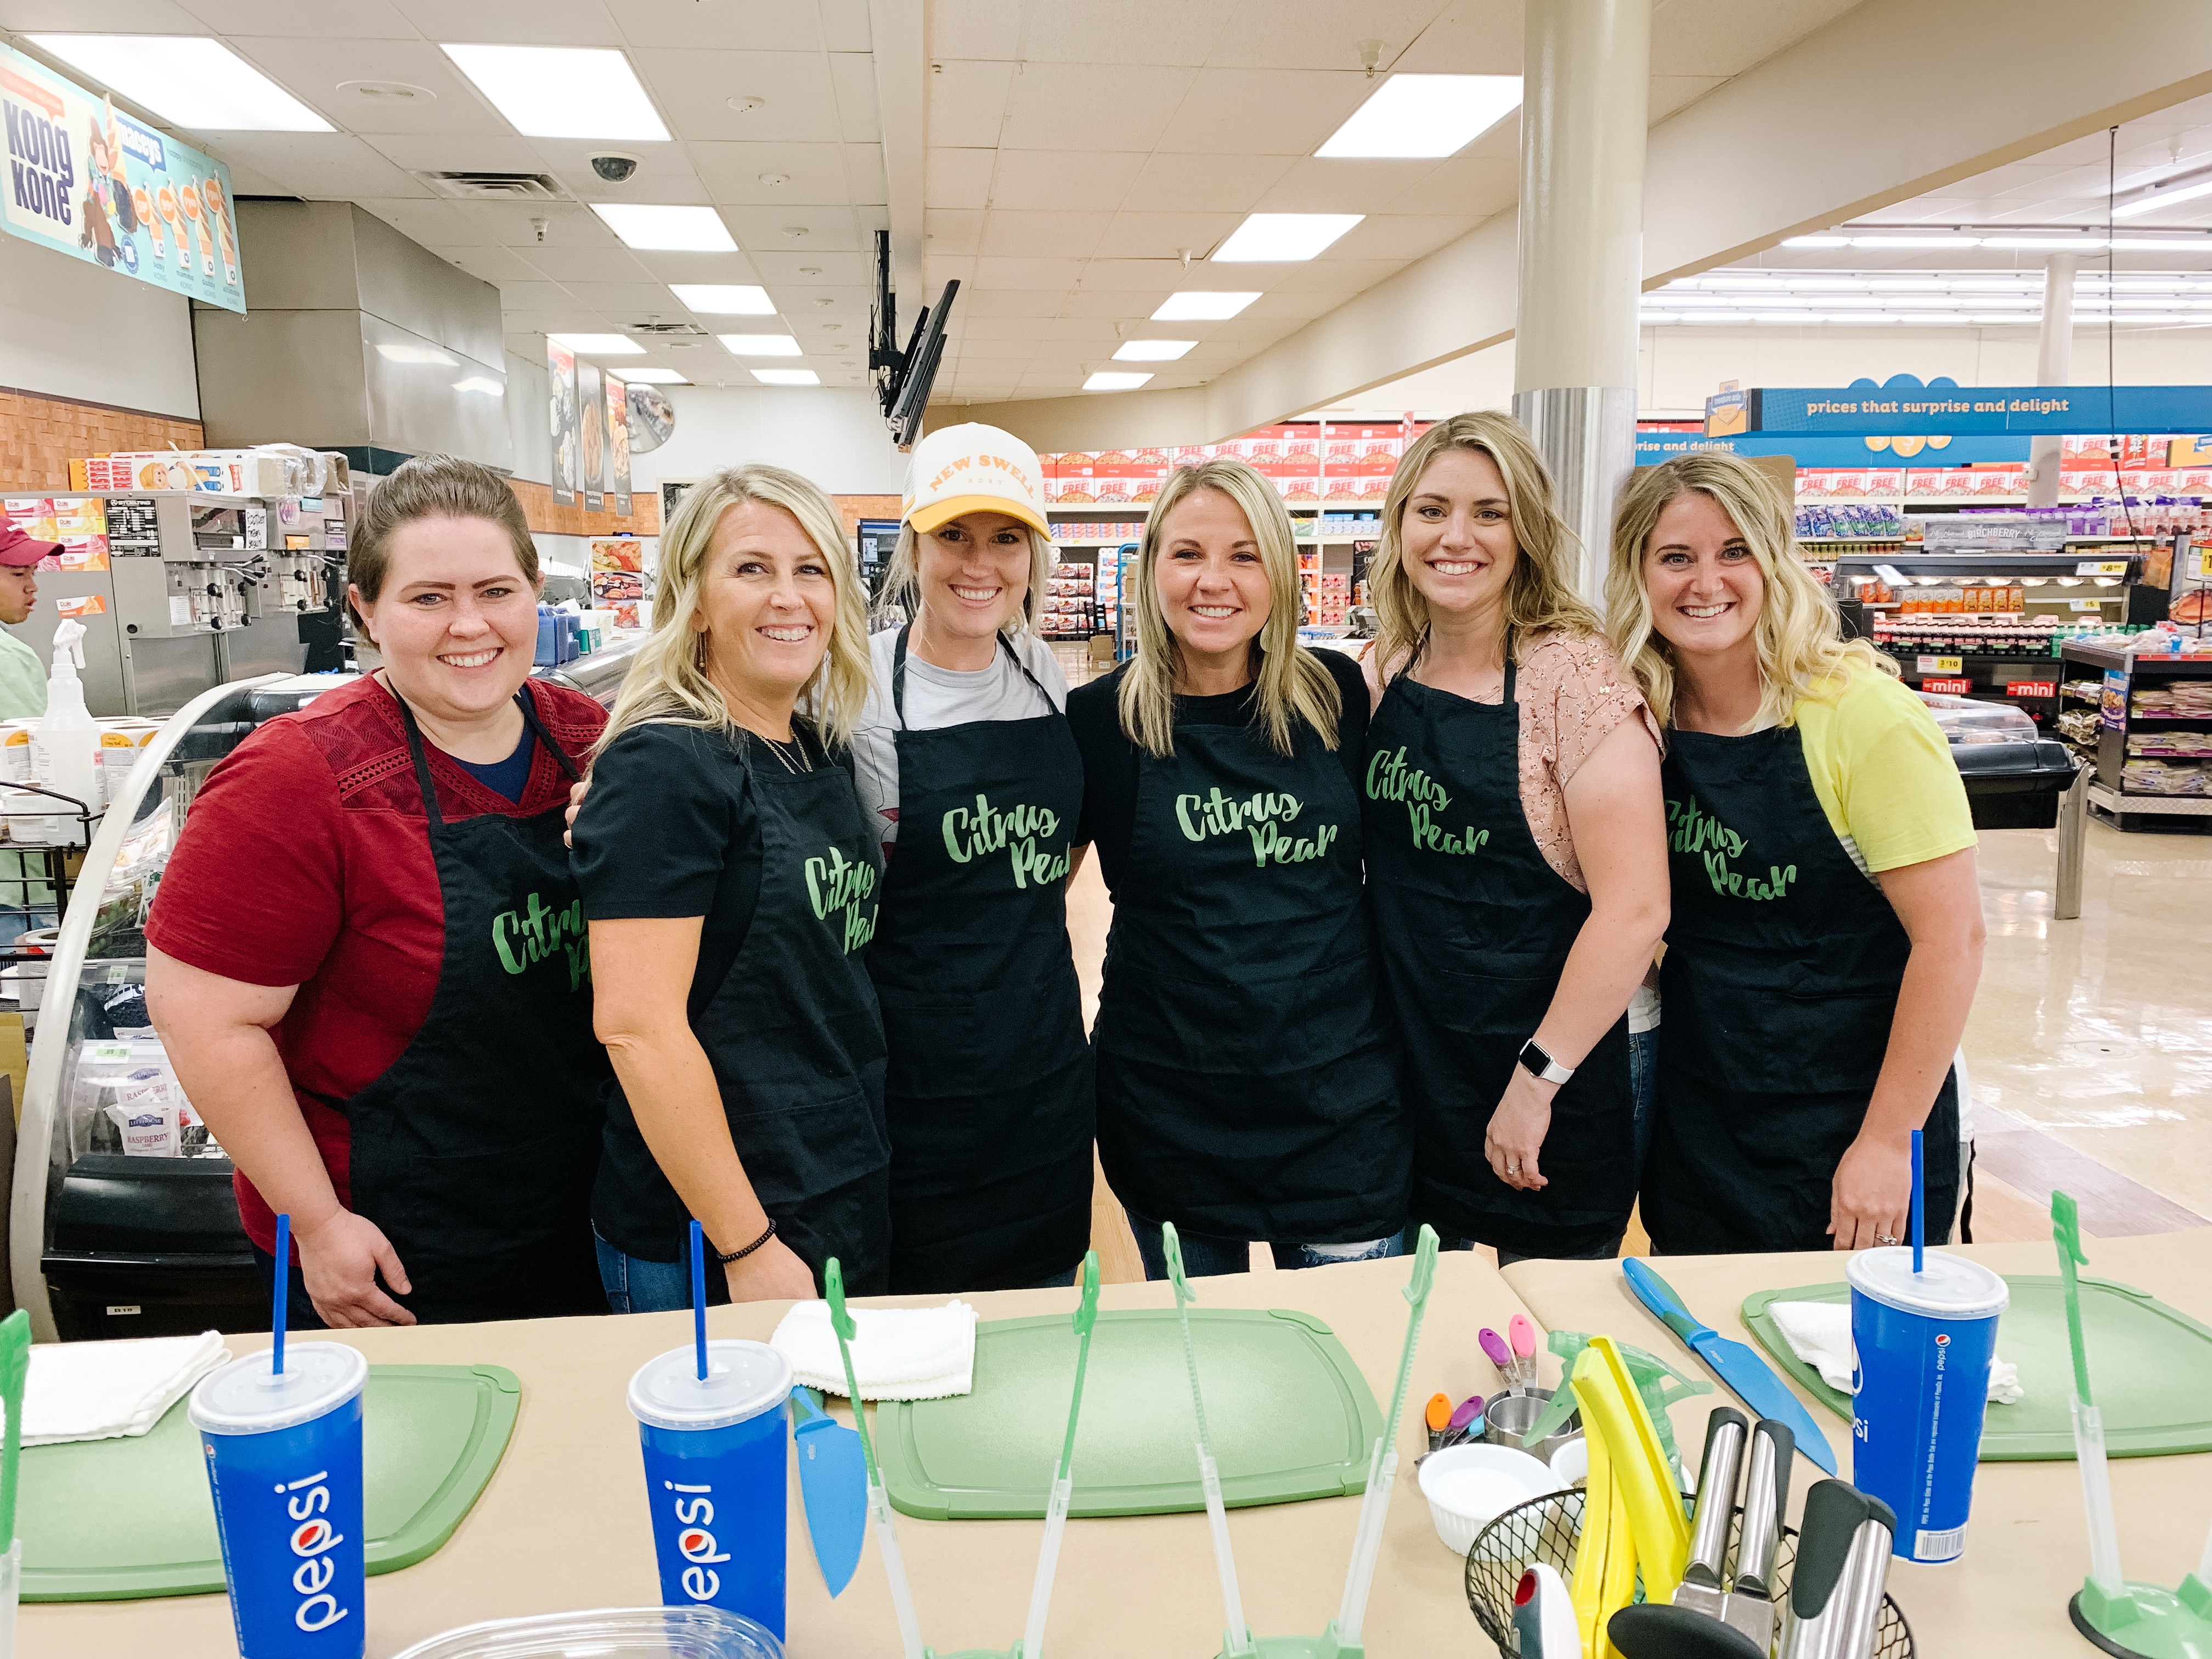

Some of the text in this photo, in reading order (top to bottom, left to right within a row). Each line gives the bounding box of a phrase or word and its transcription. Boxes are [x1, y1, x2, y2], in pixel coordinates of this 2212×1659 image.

[1807, 398, 2069, 416] prices that surprise and delight
[1215, 443, 1242, 454] FREE!
[1252, 443, 1279, 454] FREE!
[1288, 443, 1314, 454] FREE!
[1329, 444, 1355, 455] FREE!
[1366, 443, 1392, 454] FREE!
[1663, 441, 1687, 451] and
[1690, 441, 1735, 452] delight
[2083, 439, 2108, 449] FREE!
[89, 460, 110, 491] ASTES
[111, 461, 133, 492] REAT!
[929, 454, 1034, 499] NEW SWELL
[2082, 476, 2107, 485] FREE!
[2148, 476, 2173, 486] FREE!
[2186, 475, 2210, 485] FREE!
[1063, 483, 1089, 493] FREE!
[1101, 483, 1126, 493] FREE!
[1288, 482, 1314, 493] FREE!
[1329, 481, 1356, 493] FREE!
[1802, 477, 1827, 488] FREE!
[1836, 477, 1861, 488] FREE!
[1871, 477, 1896, 487] FREE!
[1912, 477, 1937, 487] FREE!
[1945, 477, 1971, 487] FREE!
[1980, 477, 2006, 488] FREE!
[1968, 527, 2021, 539] BIRCHBERRY
[1933, 680, 1966, 693] mini
[2018, 683, 2053, 696] mini
[1366, 746, 1453, 811] Citrus
[1176, 787, 1304, 842] Citrus
[942, 794, 1060, 863] Citrus
[1407, 800, 1489, 855] Pear
[1247, 820, 1338, 867] Pear
[1704, 850, 1797, 901] Pear
[805, 847, 876, 920] Citrus
[493, 893, 586, 974] Citru
[127, 1132, 168, 1144] RASPBERRY
[1937, 1347, 1946, 1370] pepsi
[664, 1480, 731, 1601] epsi
[274, 1471, 348, 1632] pepsi
